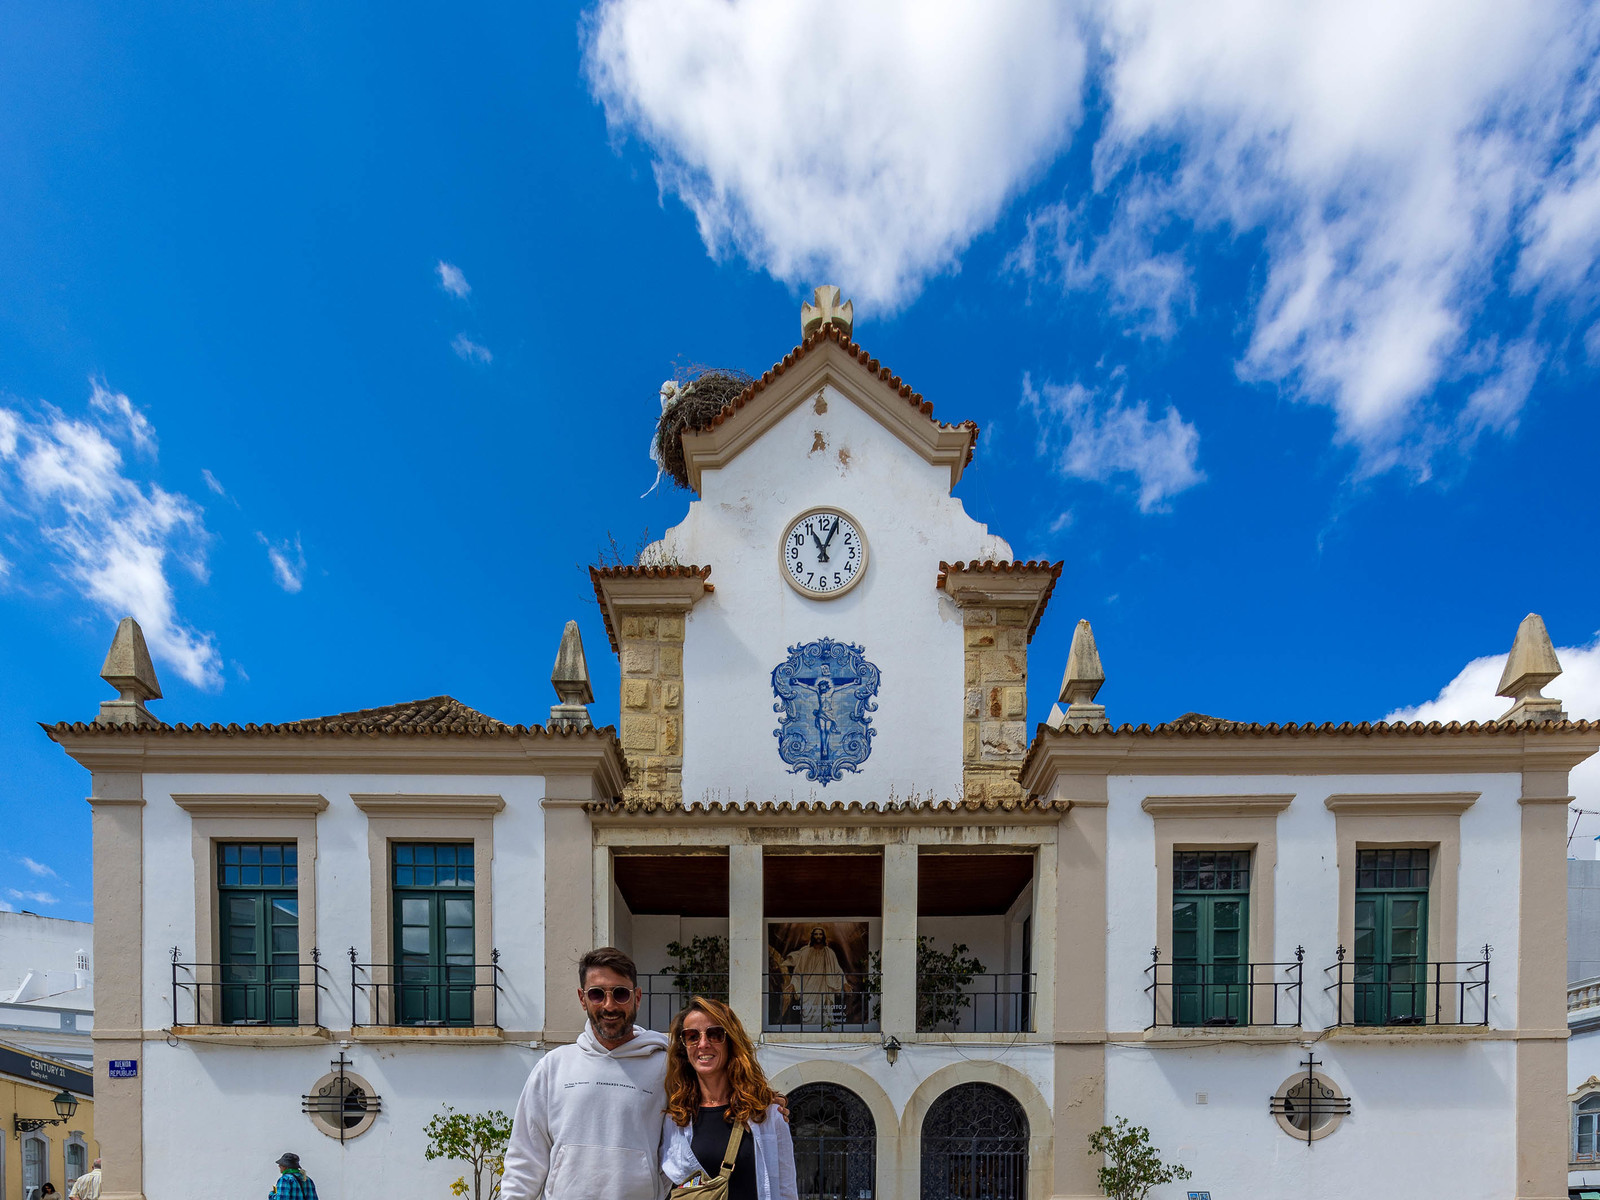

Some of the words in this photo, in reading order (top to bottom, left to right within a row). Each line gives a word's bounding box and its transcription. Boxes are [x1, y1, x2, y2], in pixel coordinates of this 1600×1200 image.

[805, 523, 813, 536] 11
[818, 519, 830, 531] 12
[794, 534, 804, 546] 10
[844, 533, 852, 545] 2
[791, 547, 798, 559] 9
[848, 547, 856, 559] 3
[796, 561, 803, 574] 8
[844, 561, 852, 573] 4
[807, 572, 814, 585] 7
[820, 576, 827, 588] 6
[834, 572, 841, 584] 5
[30, 1059, 59, 1076] CENTURY
[59, 1068, 66, 1077] 21
